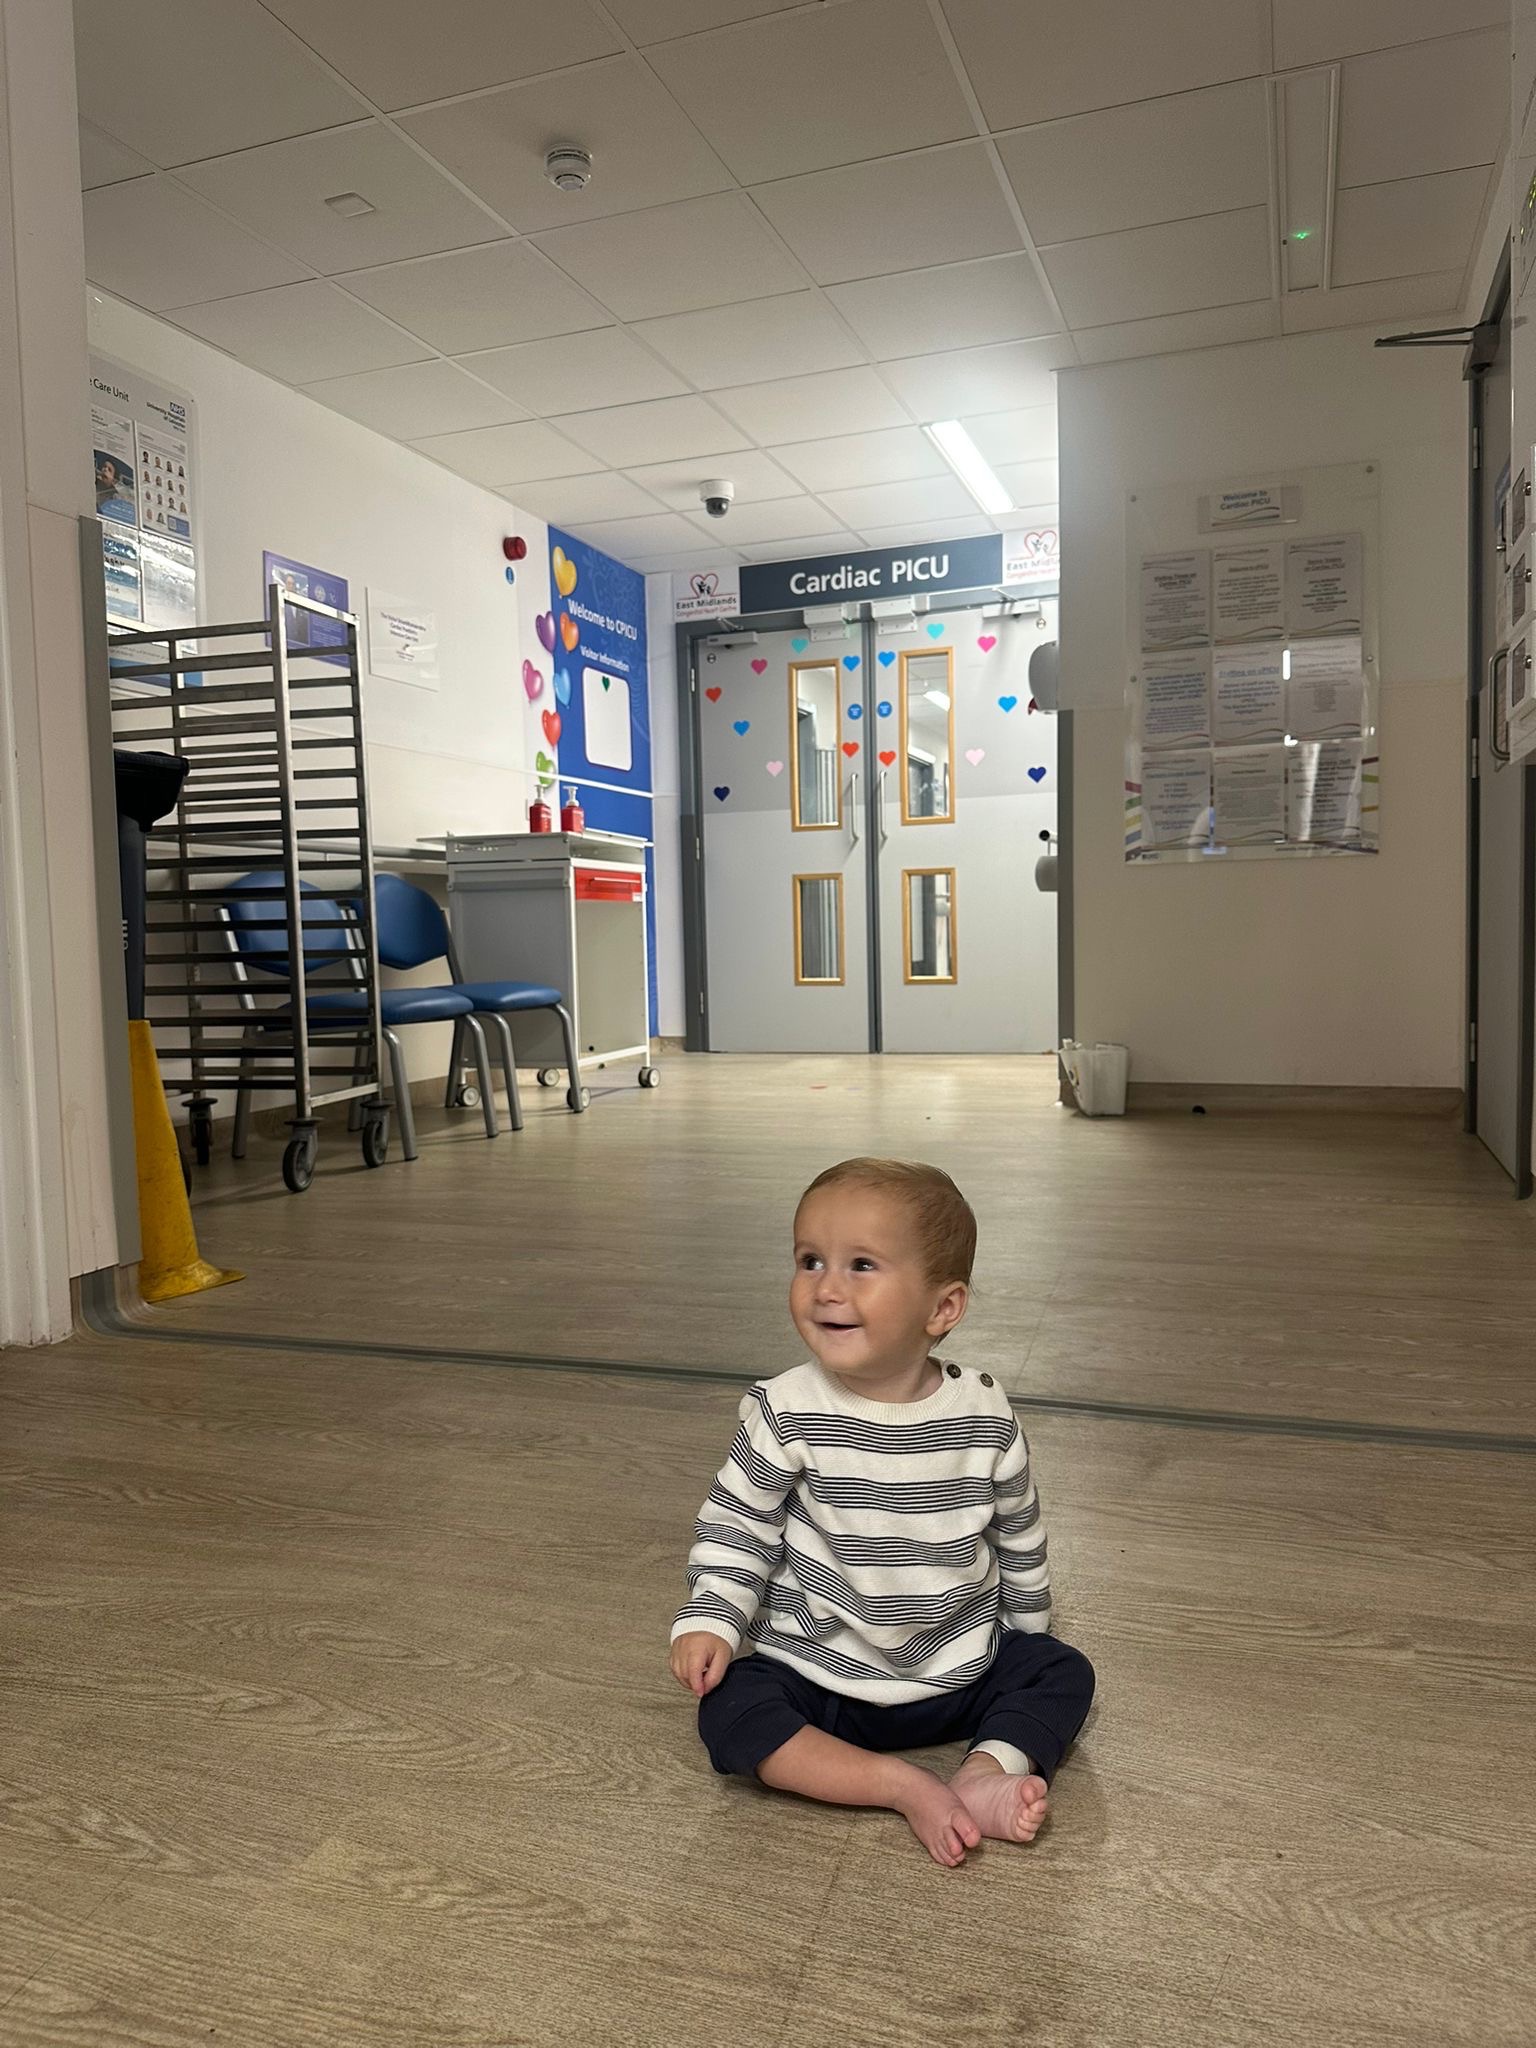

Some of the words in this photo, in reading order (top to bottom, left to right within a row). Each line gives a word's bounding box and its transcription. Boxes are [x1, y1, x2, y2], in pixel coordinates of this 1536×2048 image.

[93, 378, 112, 394] Care
[112, 386, 129, 402] Unit
[1221, 501, 1249, 510] Cardiac
[1251, 497, 1271, 506] PICU
[1223, 492, 1257, 501] Welcome
[789, 566, 881, 595] Cardiac
[891, 554, 949, 584] PICU
[1007, 561, 1027, 571] East
[676, 601, 694, 610] East
[697, 597, 737, 607] Midlands
[567, 598, 606, 628] Welcome
[606, 615, 615, 632] to
[615, 619, 637, 641] CPICU
[580, 644, 599, 661] Visitor
[599, 652, 630, 673] Information
